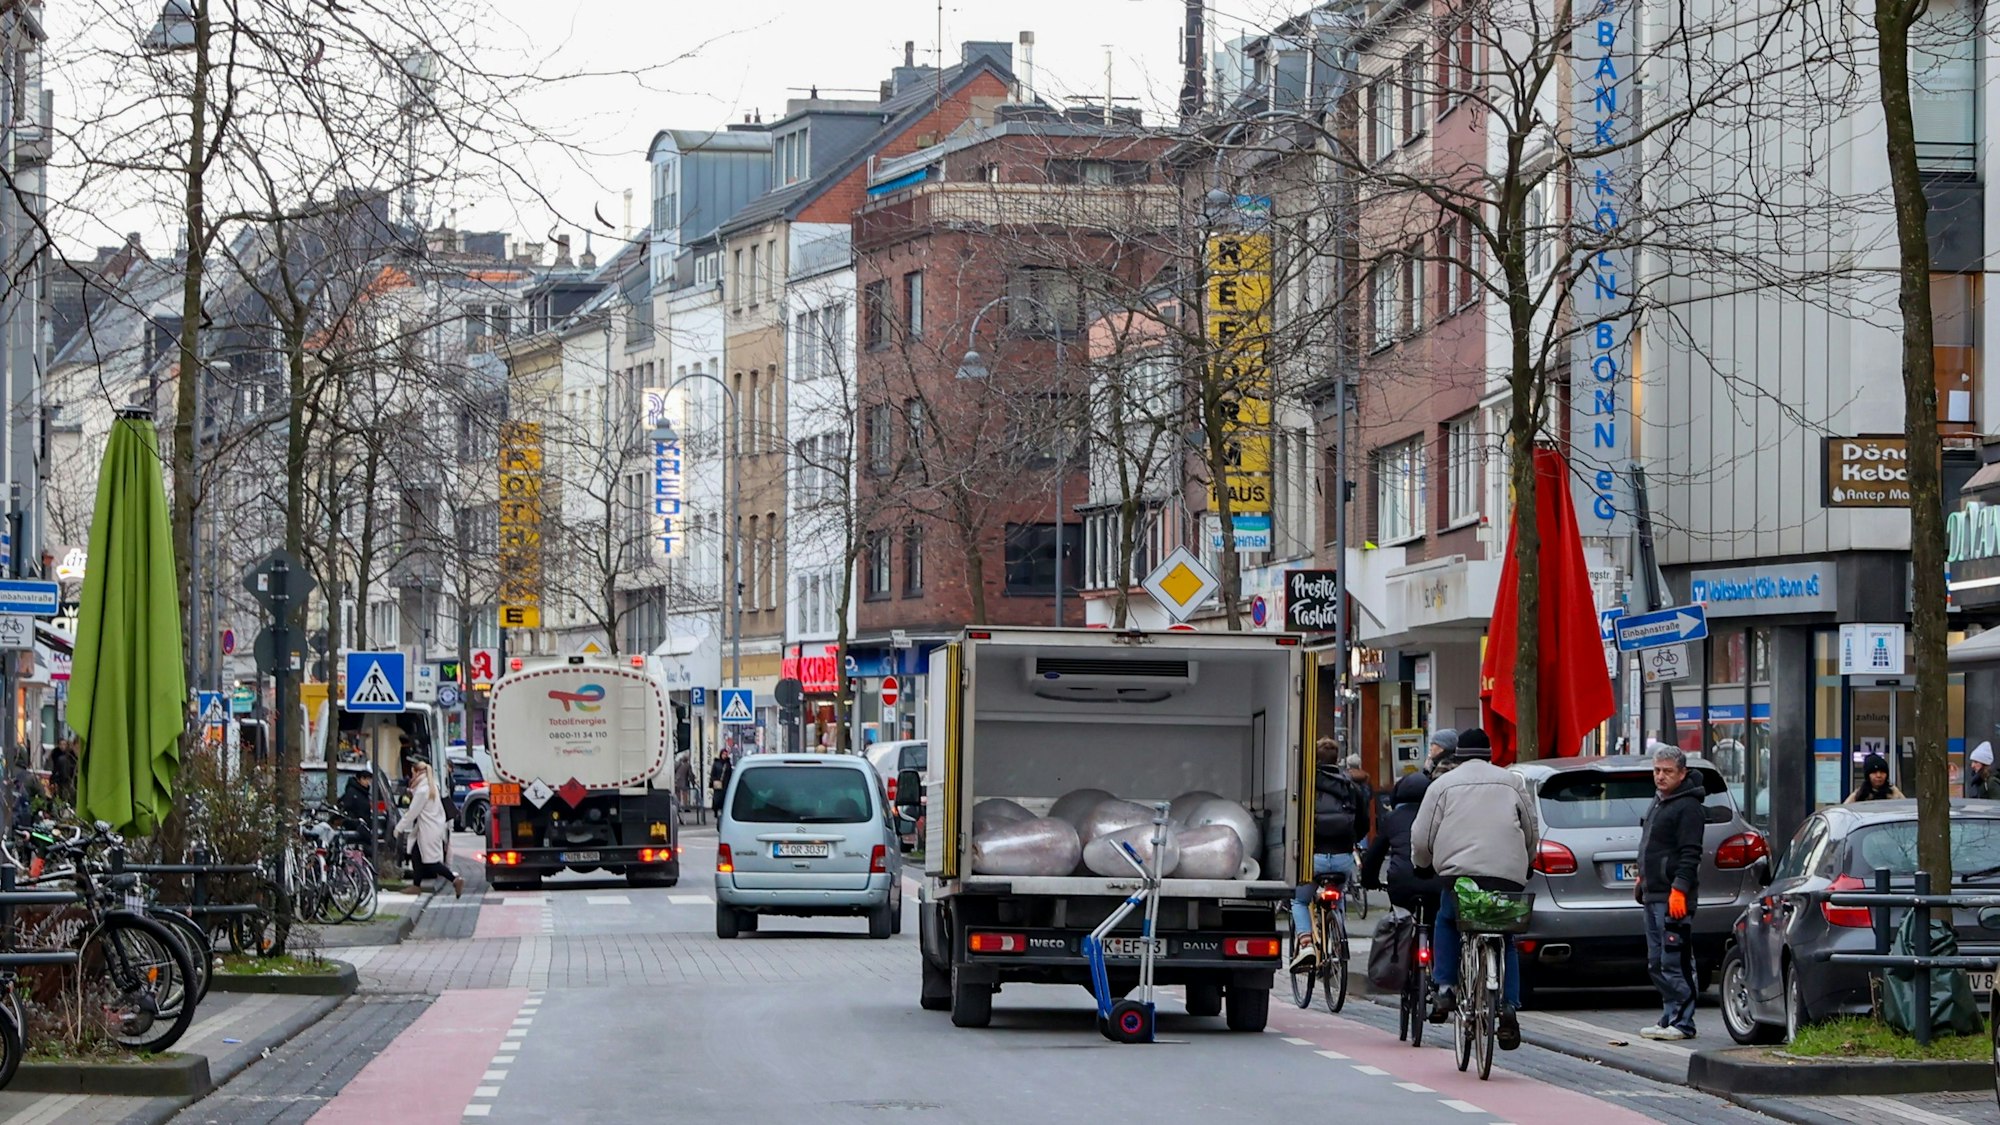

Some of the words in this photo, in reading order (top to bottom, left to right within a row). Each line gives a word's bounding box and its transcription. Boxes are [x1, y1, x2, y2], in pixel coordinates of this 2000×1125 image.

[1594, 170, 1617, 299] KÖLN
[1593, 323, 1617, 448] BONN
[1593, 470, 1616, 520] eG
[1846, 489, 1885, 502] Antep
[1709, 577, 1755, 602] Volksbank
[1755, 576, 1778, 599] Köln
[1779, 576, 1804, 598] Bonn
[1805, 572, 1820, 596] eG
[1621, 621, 1681, 639] Einbahnstraße
[549, 717, 607, 727] TotalEnergies
[549, 731, 581, 739] 0800-11
[778, 844, 785, 854] K
[790, 844, 803, 854] QR
[804, 844, 826, 854] 3037
[1624, 865, 1633, 878] K
[1030, 938, 1065, 949] IVECO
[1104, 939, 1113, 953] K
[1123, 940, 1140, 953] EF
[1183, 942, 1218, 950] DAILY
